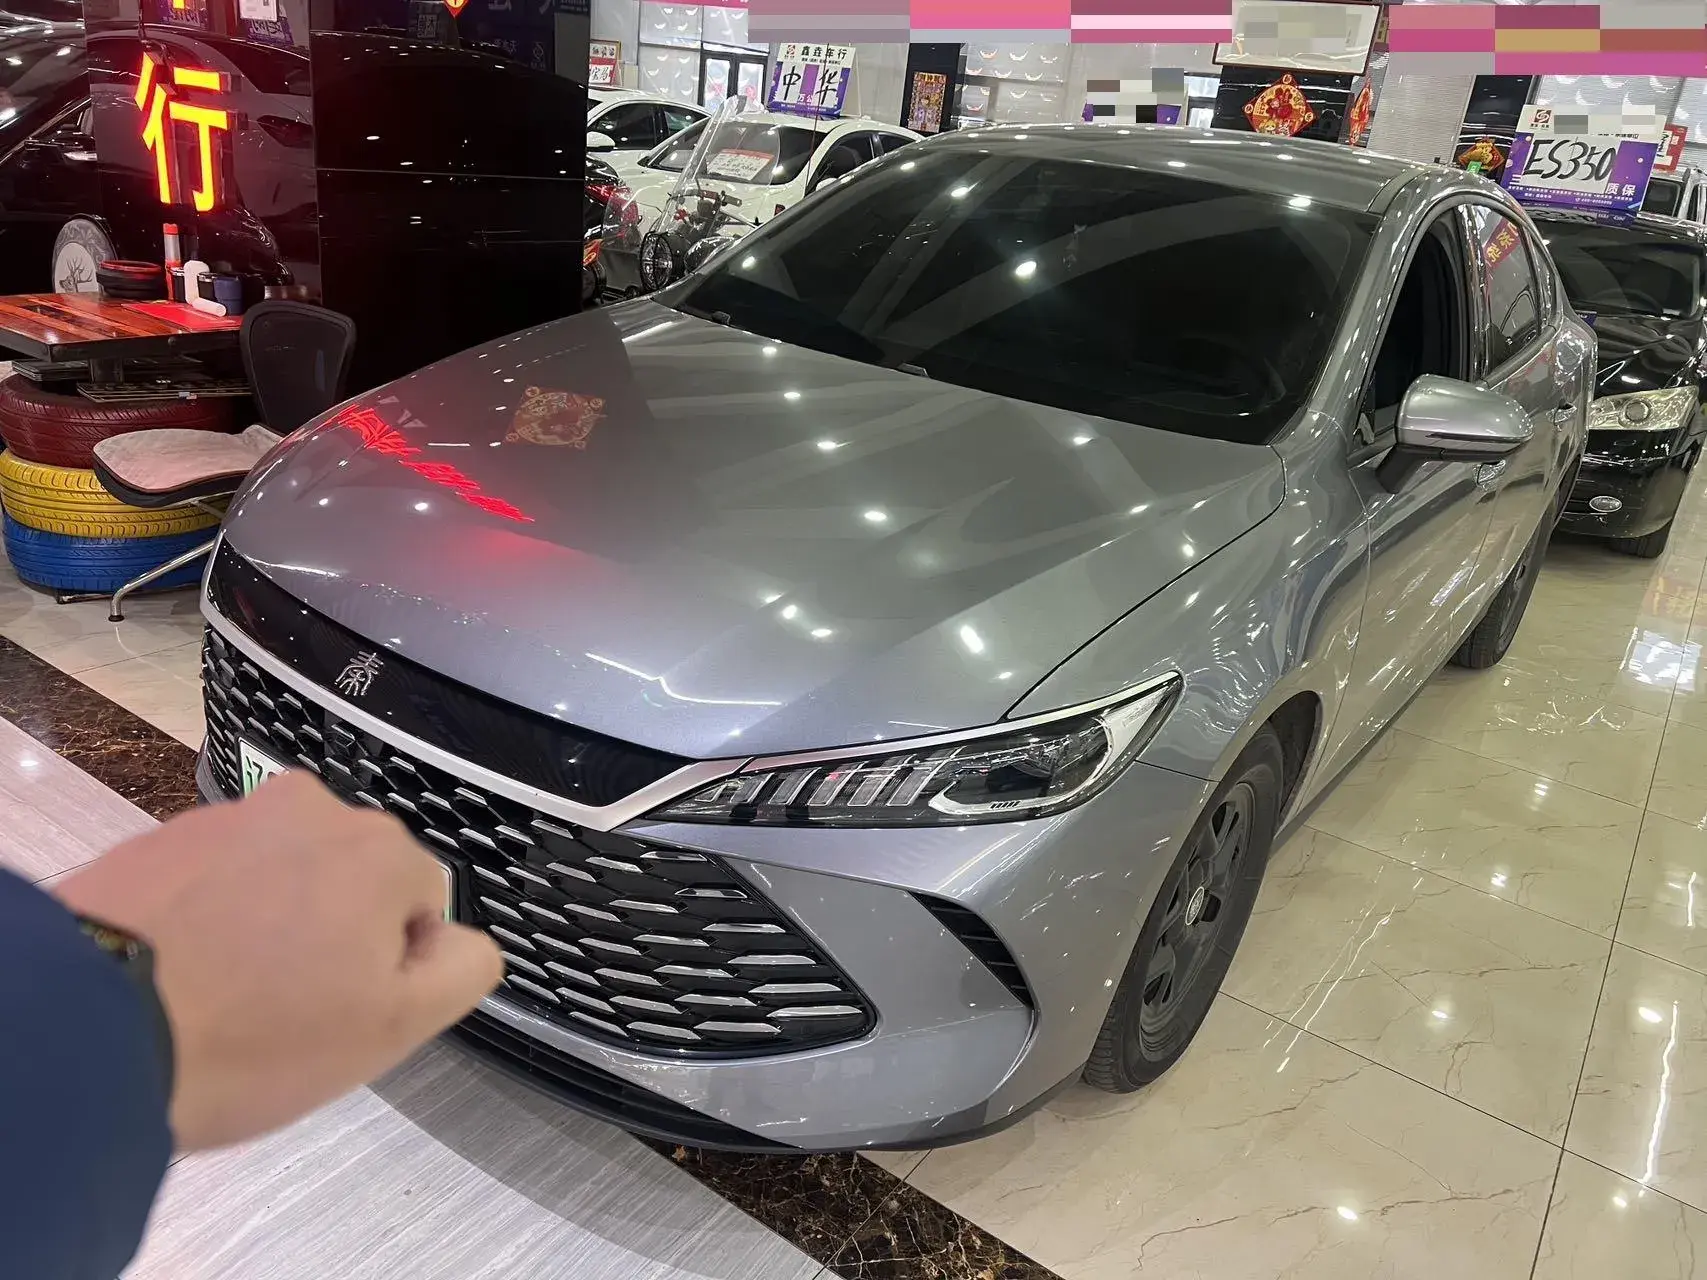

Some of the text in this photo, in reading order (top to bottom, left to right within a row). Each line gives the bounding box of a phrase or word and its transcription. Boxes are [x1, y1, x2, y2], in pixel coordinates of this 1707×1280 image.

[133, 50, 229, 213] 行
[1522, 137, 1617, 182] ES350
[1605, 182, 1637, 197] 质保
